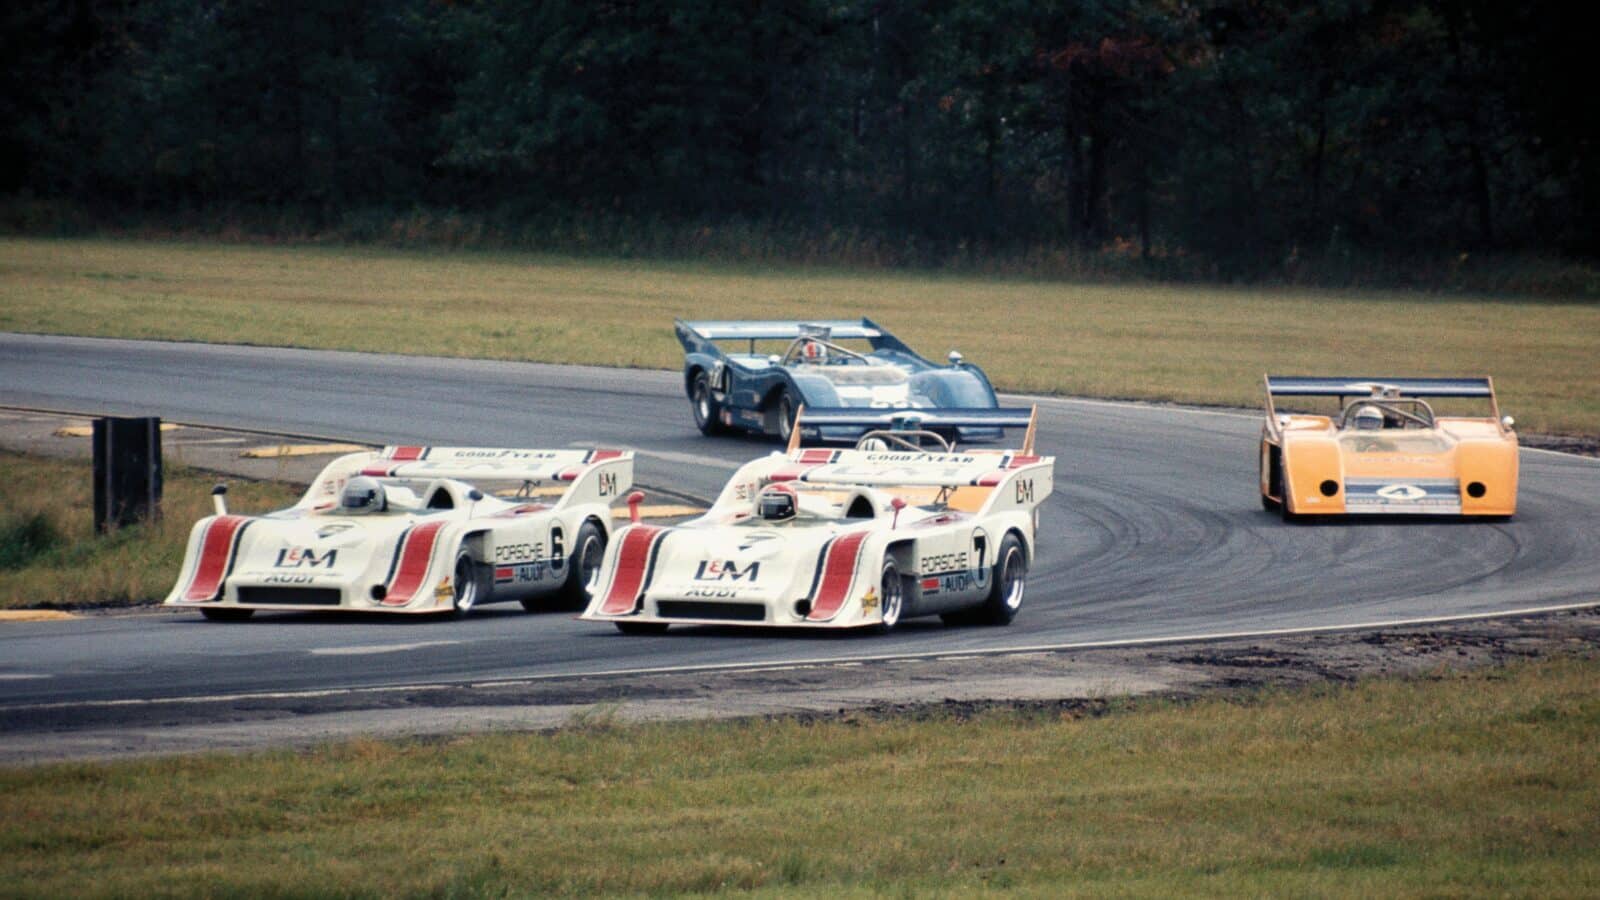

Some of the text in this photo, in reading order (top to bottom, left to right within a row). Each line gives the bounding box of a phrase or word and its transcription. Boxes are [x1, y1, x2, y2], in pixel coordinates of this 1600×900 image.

[273, 547, 339, 569] L&M
[495, 542, 543, 560] PORSCHE
[550, 526, 564, 570] 6
[973, 536, 986, 581] 7
[693, 559, 761, 582] L&M
[921, 552, 967, 572] PORSCHE
